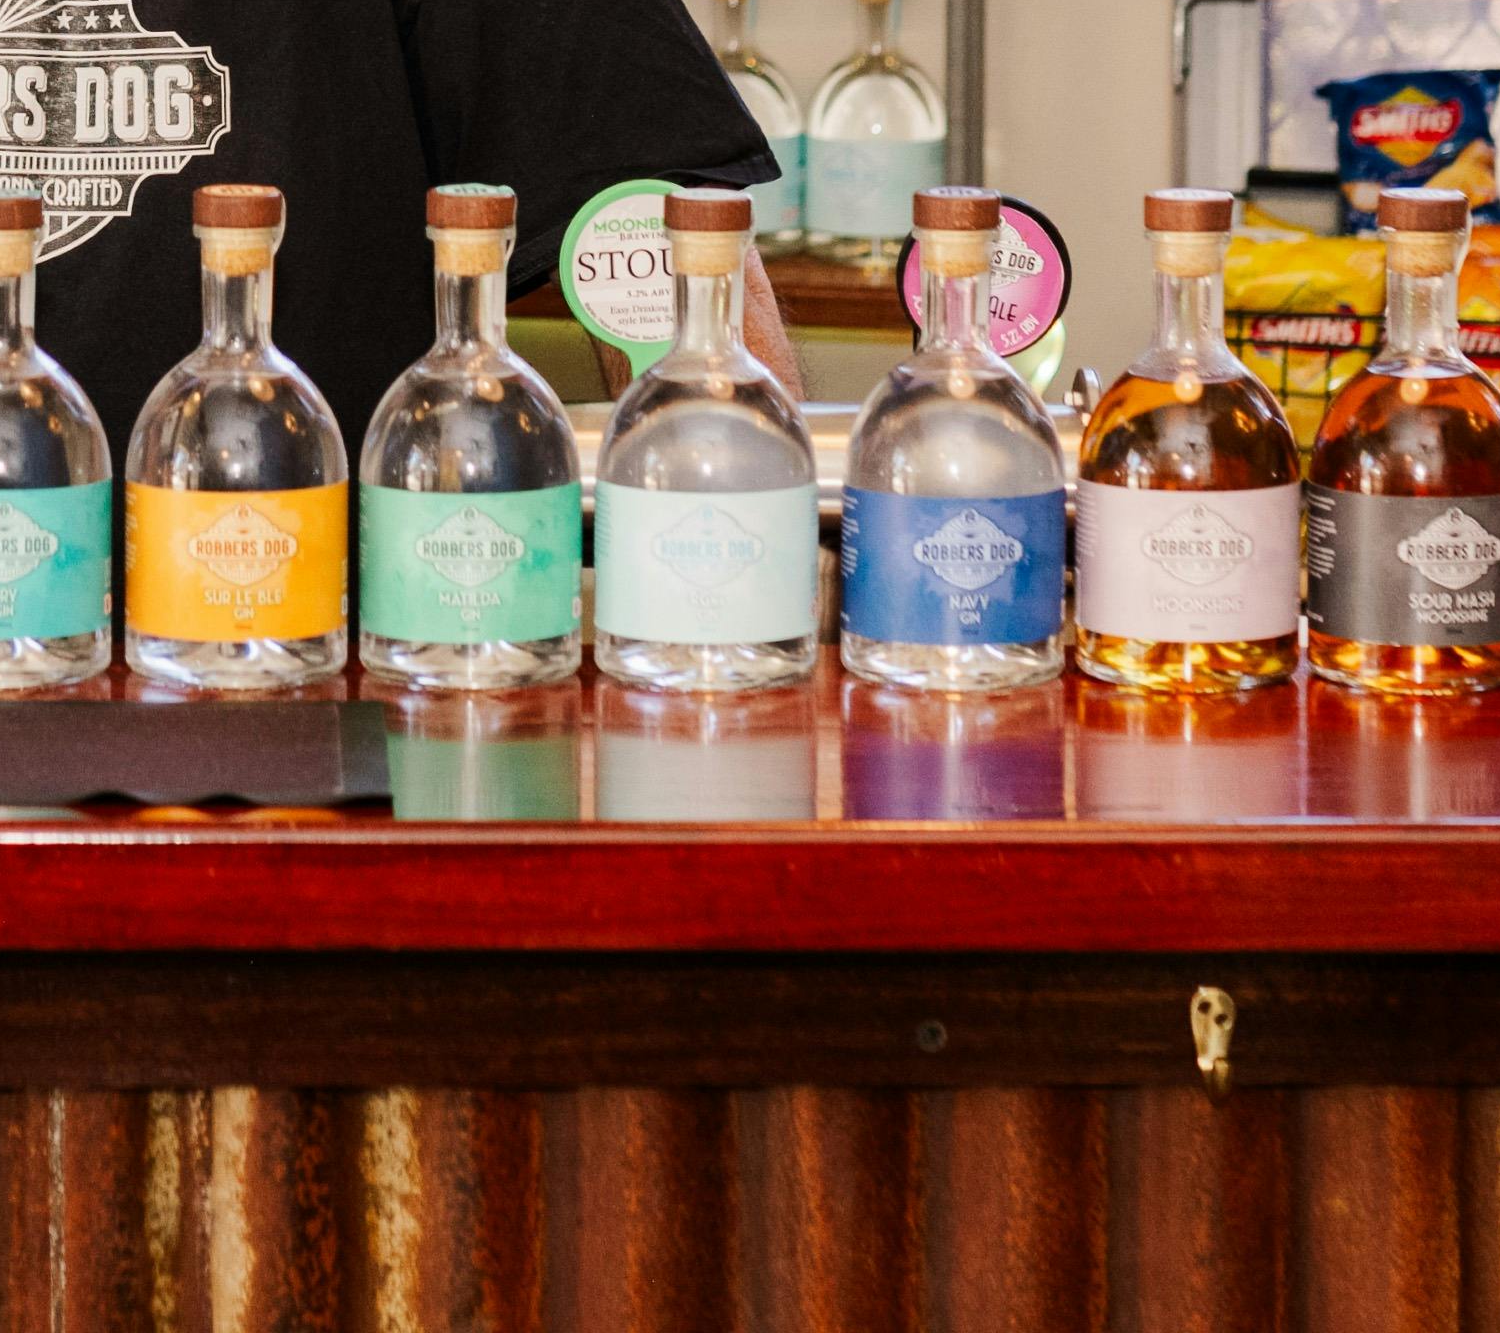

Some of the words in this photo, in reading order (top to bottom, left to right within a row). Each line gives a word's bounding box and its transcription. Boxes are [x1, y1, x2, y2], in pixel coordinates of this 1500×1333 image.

[74, 63, 195, 145] DOG
[42, 179, 123, 207] CRAFTED
[593, 217, 665, 233] MOONB
[619, 232, 668, 242] BREWIN
[578, 248, 673, 282] STOU
[1008, 250, 1036, 271] DOG
[610, 306, 630, 316] Easy
[617, 316, 638, 326] style
[639, 315, 662, 325] Black
[24, 536, 51, 554] DOG
[195, 539, 258, 557] ROBBERS
[264, 539, 290, 556] DOG
[422, 540, 485, 558] ROBBERS
[490, 540, 517, 557] DOG
[921, 543, 984, 562] ROBBERS
[990, 542, 1016, 562] DOG
[1150, 538, 1213, 556] ROBBERS
[1219, 539, 1245, 556] DOG
[1406, 543, 1469, 561] ROBBERS
[1474, 542, 1498, 561] DOG
[203, 588, 230, 606] SUR
[235, 588, 252, 606] LE
[438, 591, 502, 607] MATILDA
[950, 592, 991, 611] NAVY
[1152, 596, 1244, 614] MOONSHINE
[1408, 592, 1453, 610] SOUR
[1456, 589, 1497, 609] MASH
[233, 606, 256, 621] GIN
[459, 607, 482, 622] GIN
[958, 609, 982, 625] GIN
[1415, 608, 1490, 625] MOONSHINE
